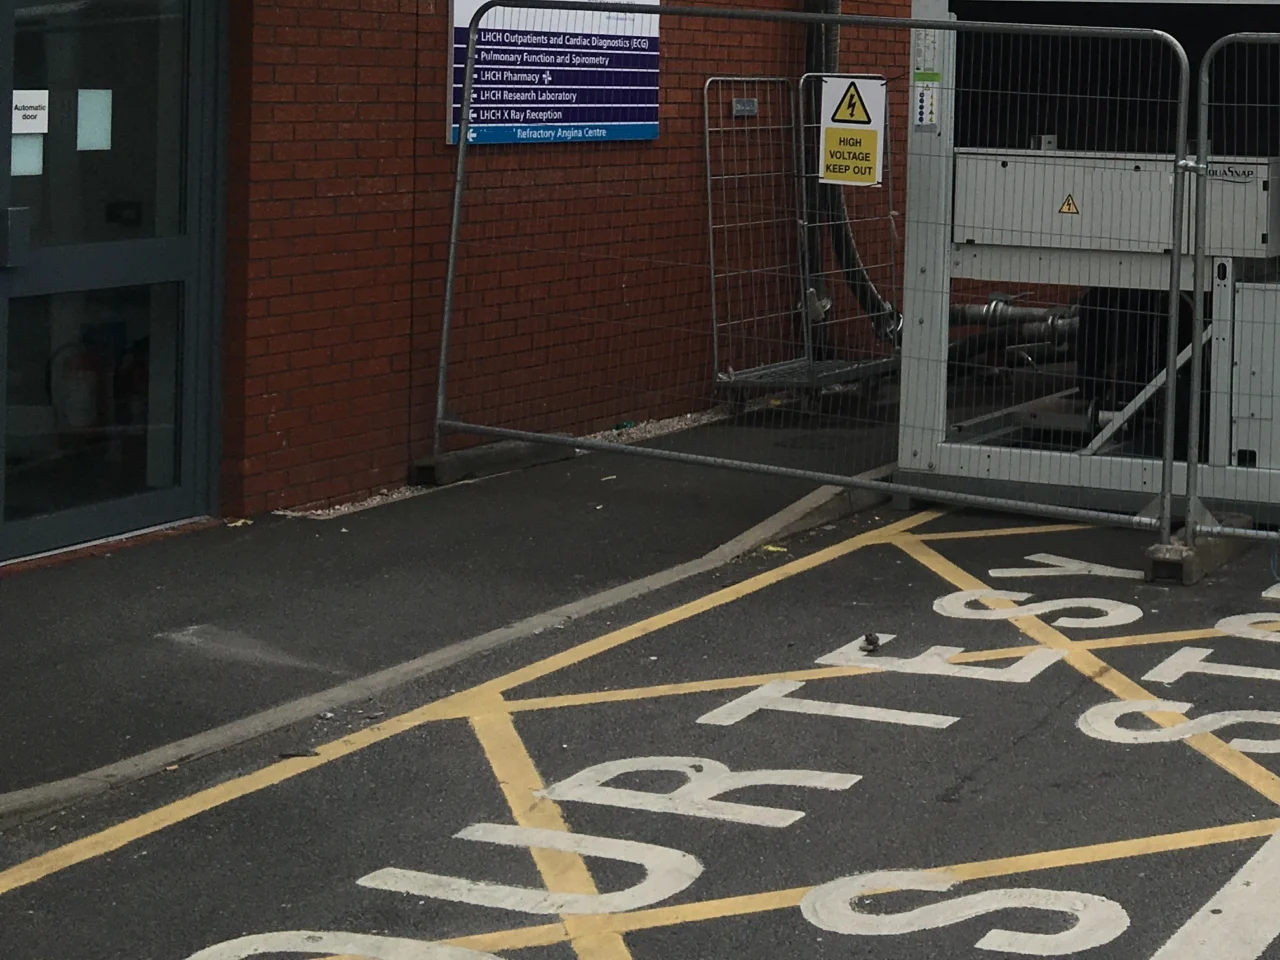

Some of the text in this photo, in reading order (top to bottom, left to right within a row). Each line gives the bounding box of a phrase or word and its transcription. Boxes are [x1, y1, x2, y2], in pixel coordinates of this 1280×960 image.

[481, 31, 649, 49] LHCH Outpatients and Cardiac Diagnostics (ECG)
[480, 51, 610, 67] Pulmonary Function and Spirometry
[480, 70, 540, 84] LHCH Pharmacy
[480, 90, 578, 103] LHCH Research Laboratory
[480, 109, 563, 122] LHCH X Ray Reception
[517, 128, 555, 140] Refractory
[557, 127, 583, 139] Angina
[583, 127, 607, 137] Centre
[839, 137, 861, 147] HIGH
[829, 150, 871, 161] VOLTAGE
[826, 164, 873, 175] KEEP OUT
[1204, 166, 1254, 177] QUASNAP
